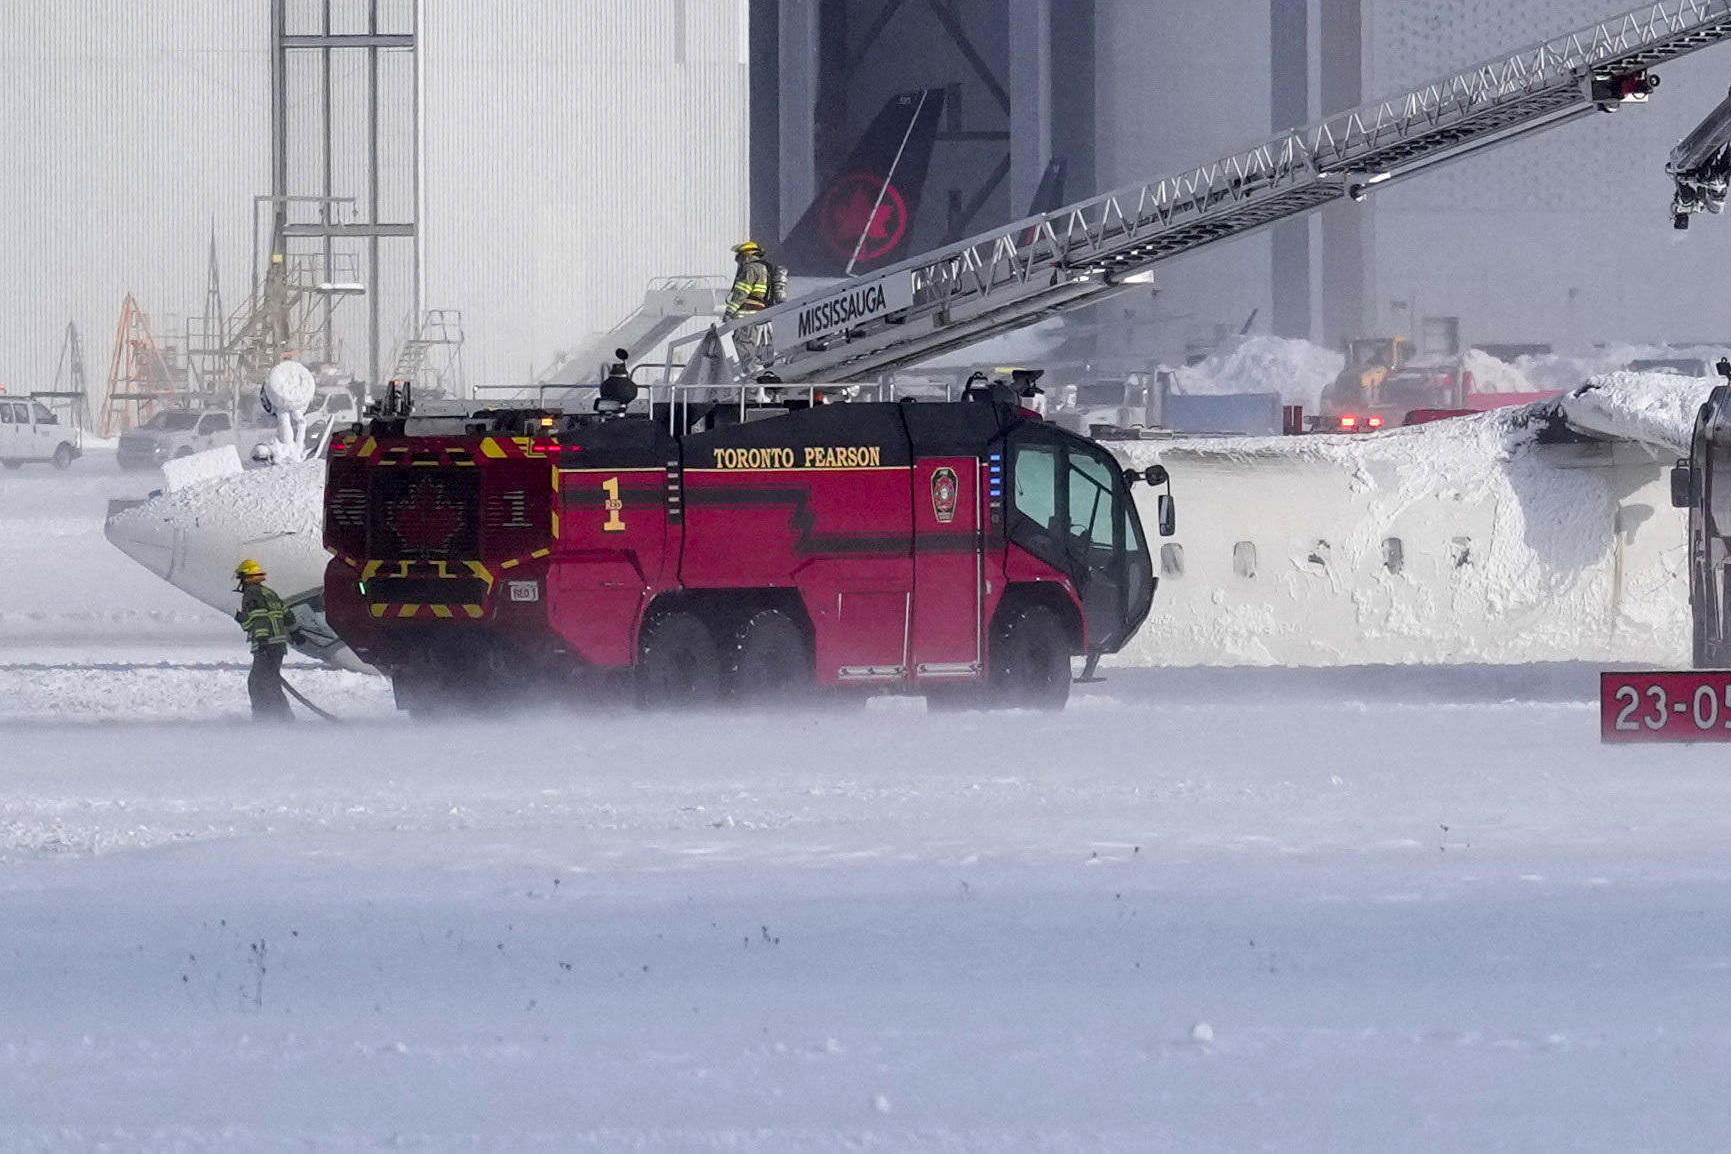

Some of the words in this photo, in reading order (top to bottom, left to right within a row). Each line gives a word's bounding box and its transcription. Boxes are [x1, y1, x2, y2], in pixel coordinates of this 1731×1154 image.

[797, 284, 887, 339] MISSISSAUGA
[713, 447, 795, 469] TORONTO
[804, 446, 881, 467] PEARSON
[602, 476, 626, 531] 1
